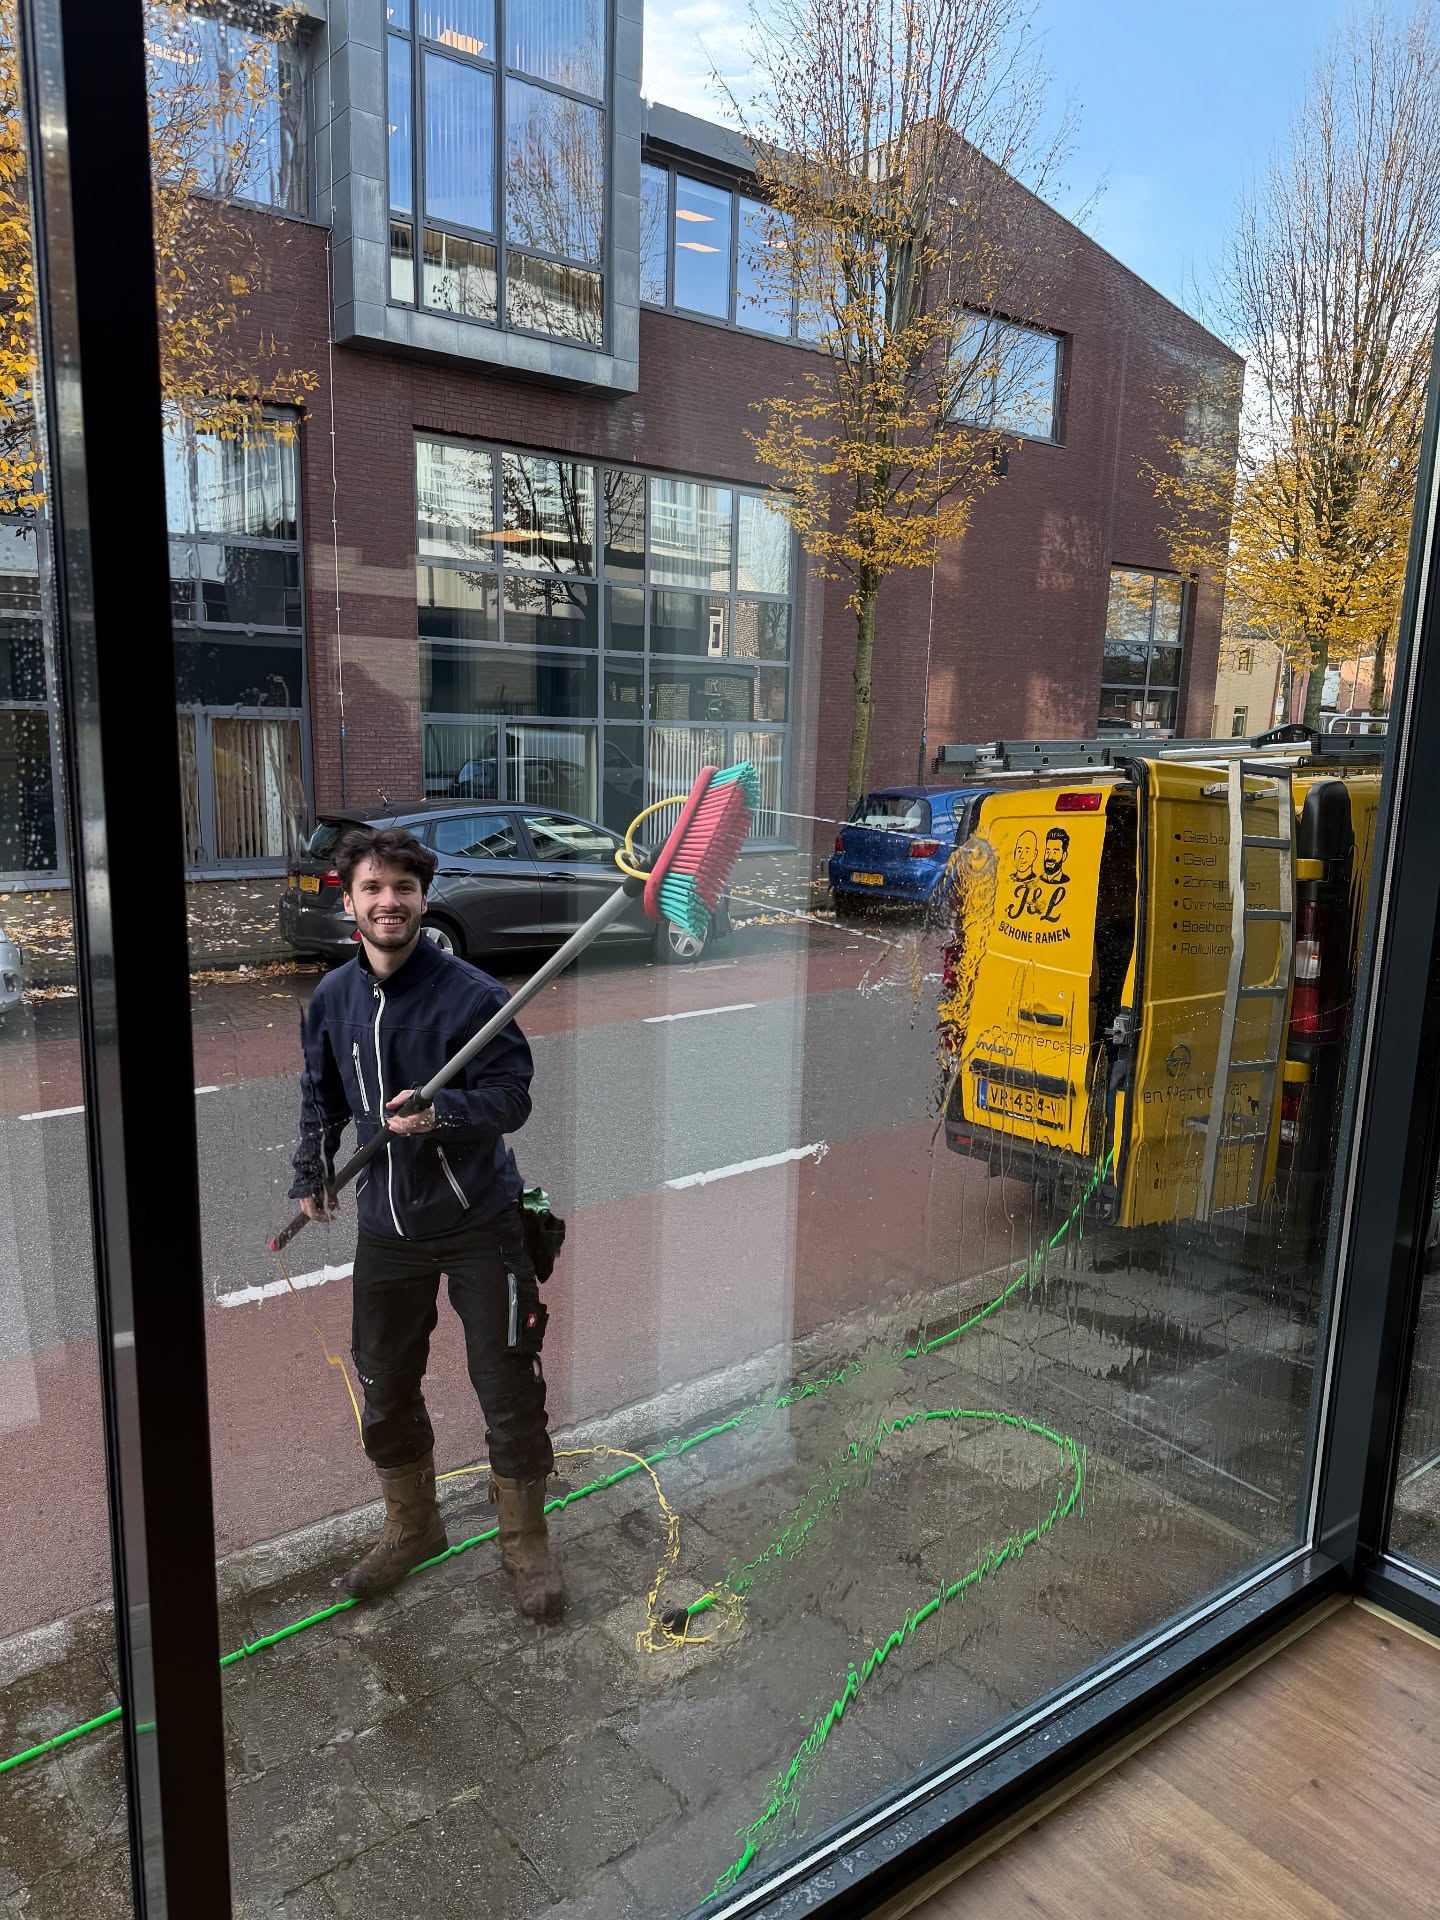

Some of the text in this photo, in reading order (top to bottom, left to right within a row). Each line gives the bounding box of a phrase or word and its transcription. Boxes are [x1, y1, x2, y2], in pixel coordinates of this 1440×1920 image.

[1005, 884, 1066, 923] J&L
[998, 920, 1071, 944] SCHONE RAMEN
[1143, 1083, 1248, 1103] en Particer
